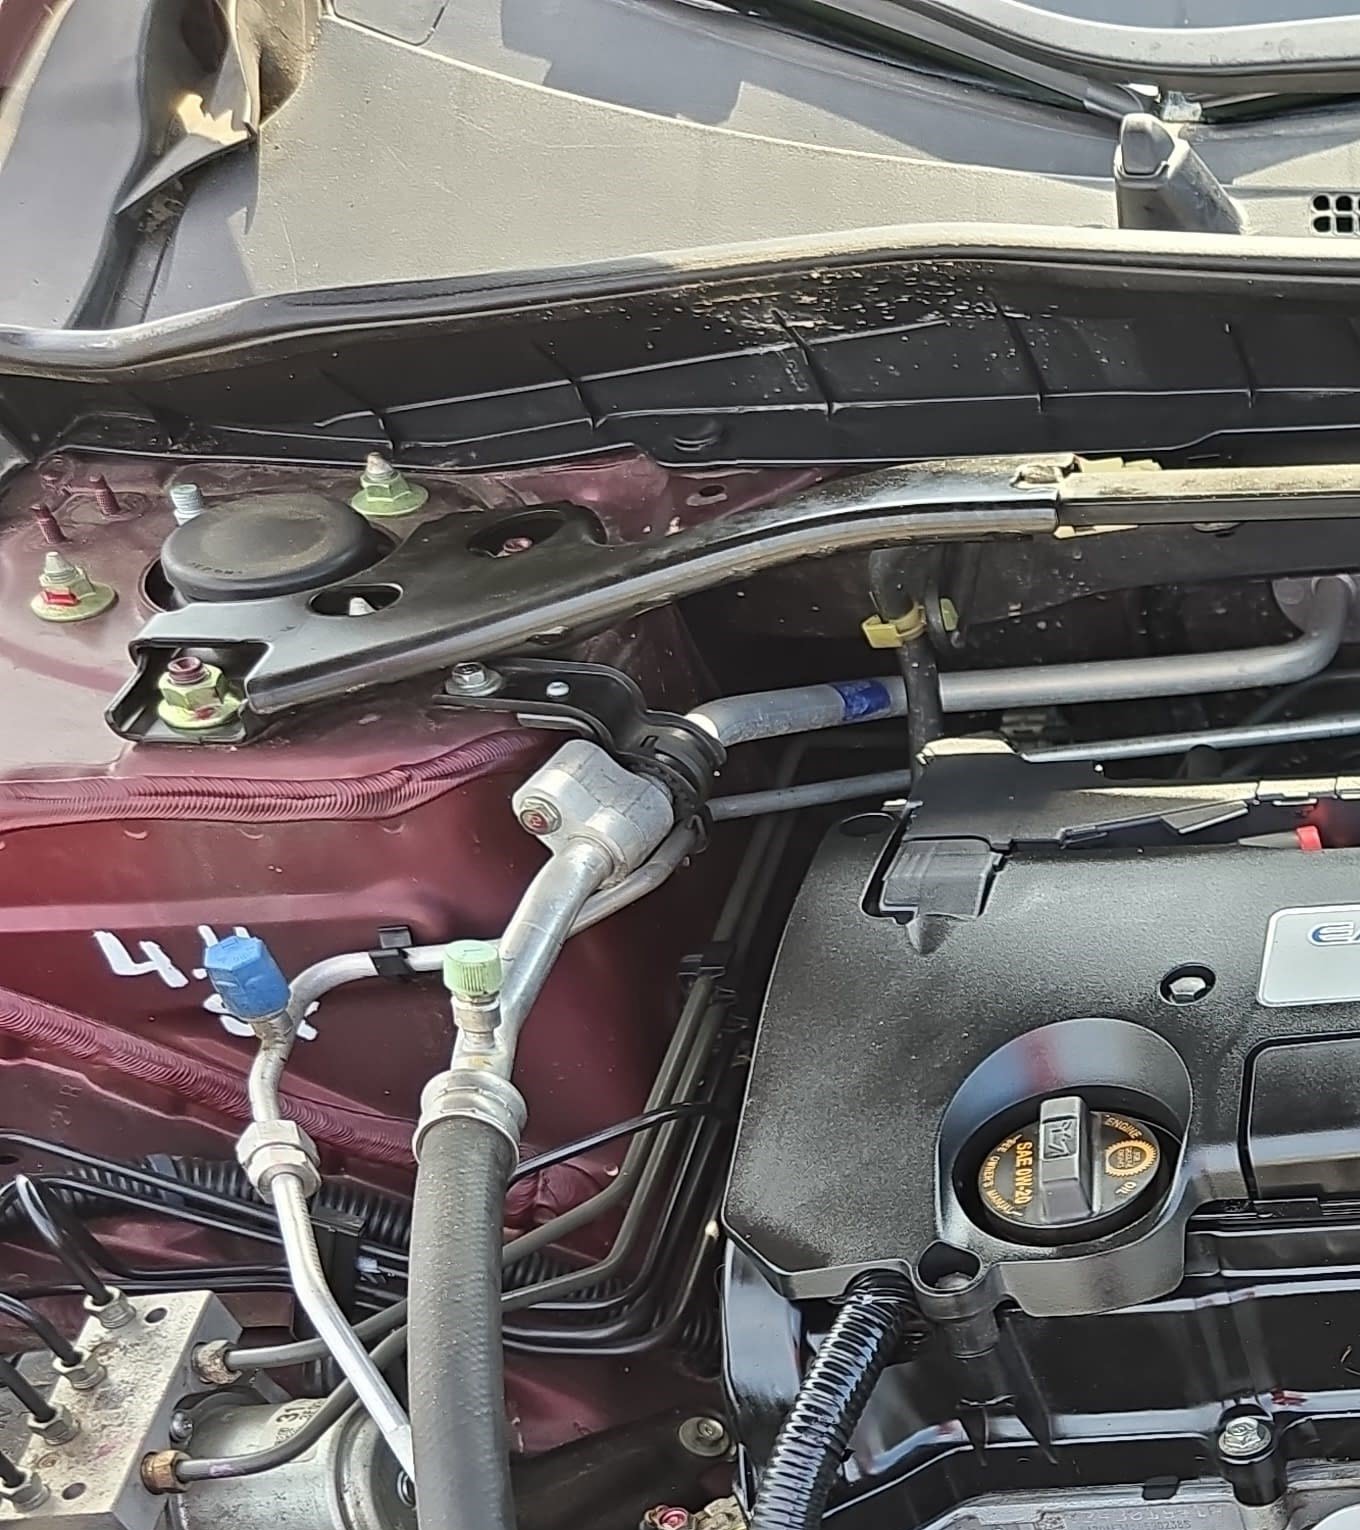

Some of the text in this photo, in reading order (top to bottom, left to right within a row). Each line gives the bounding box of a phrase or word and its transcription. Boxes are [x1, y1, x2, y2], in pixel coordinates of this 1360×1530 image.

[1105, 1114, 1144, 1140] ENGINE
[1014, 1141, 1034, 1205] SAE 0W-20
[1115, 1181, 1137, 1194] OIL
